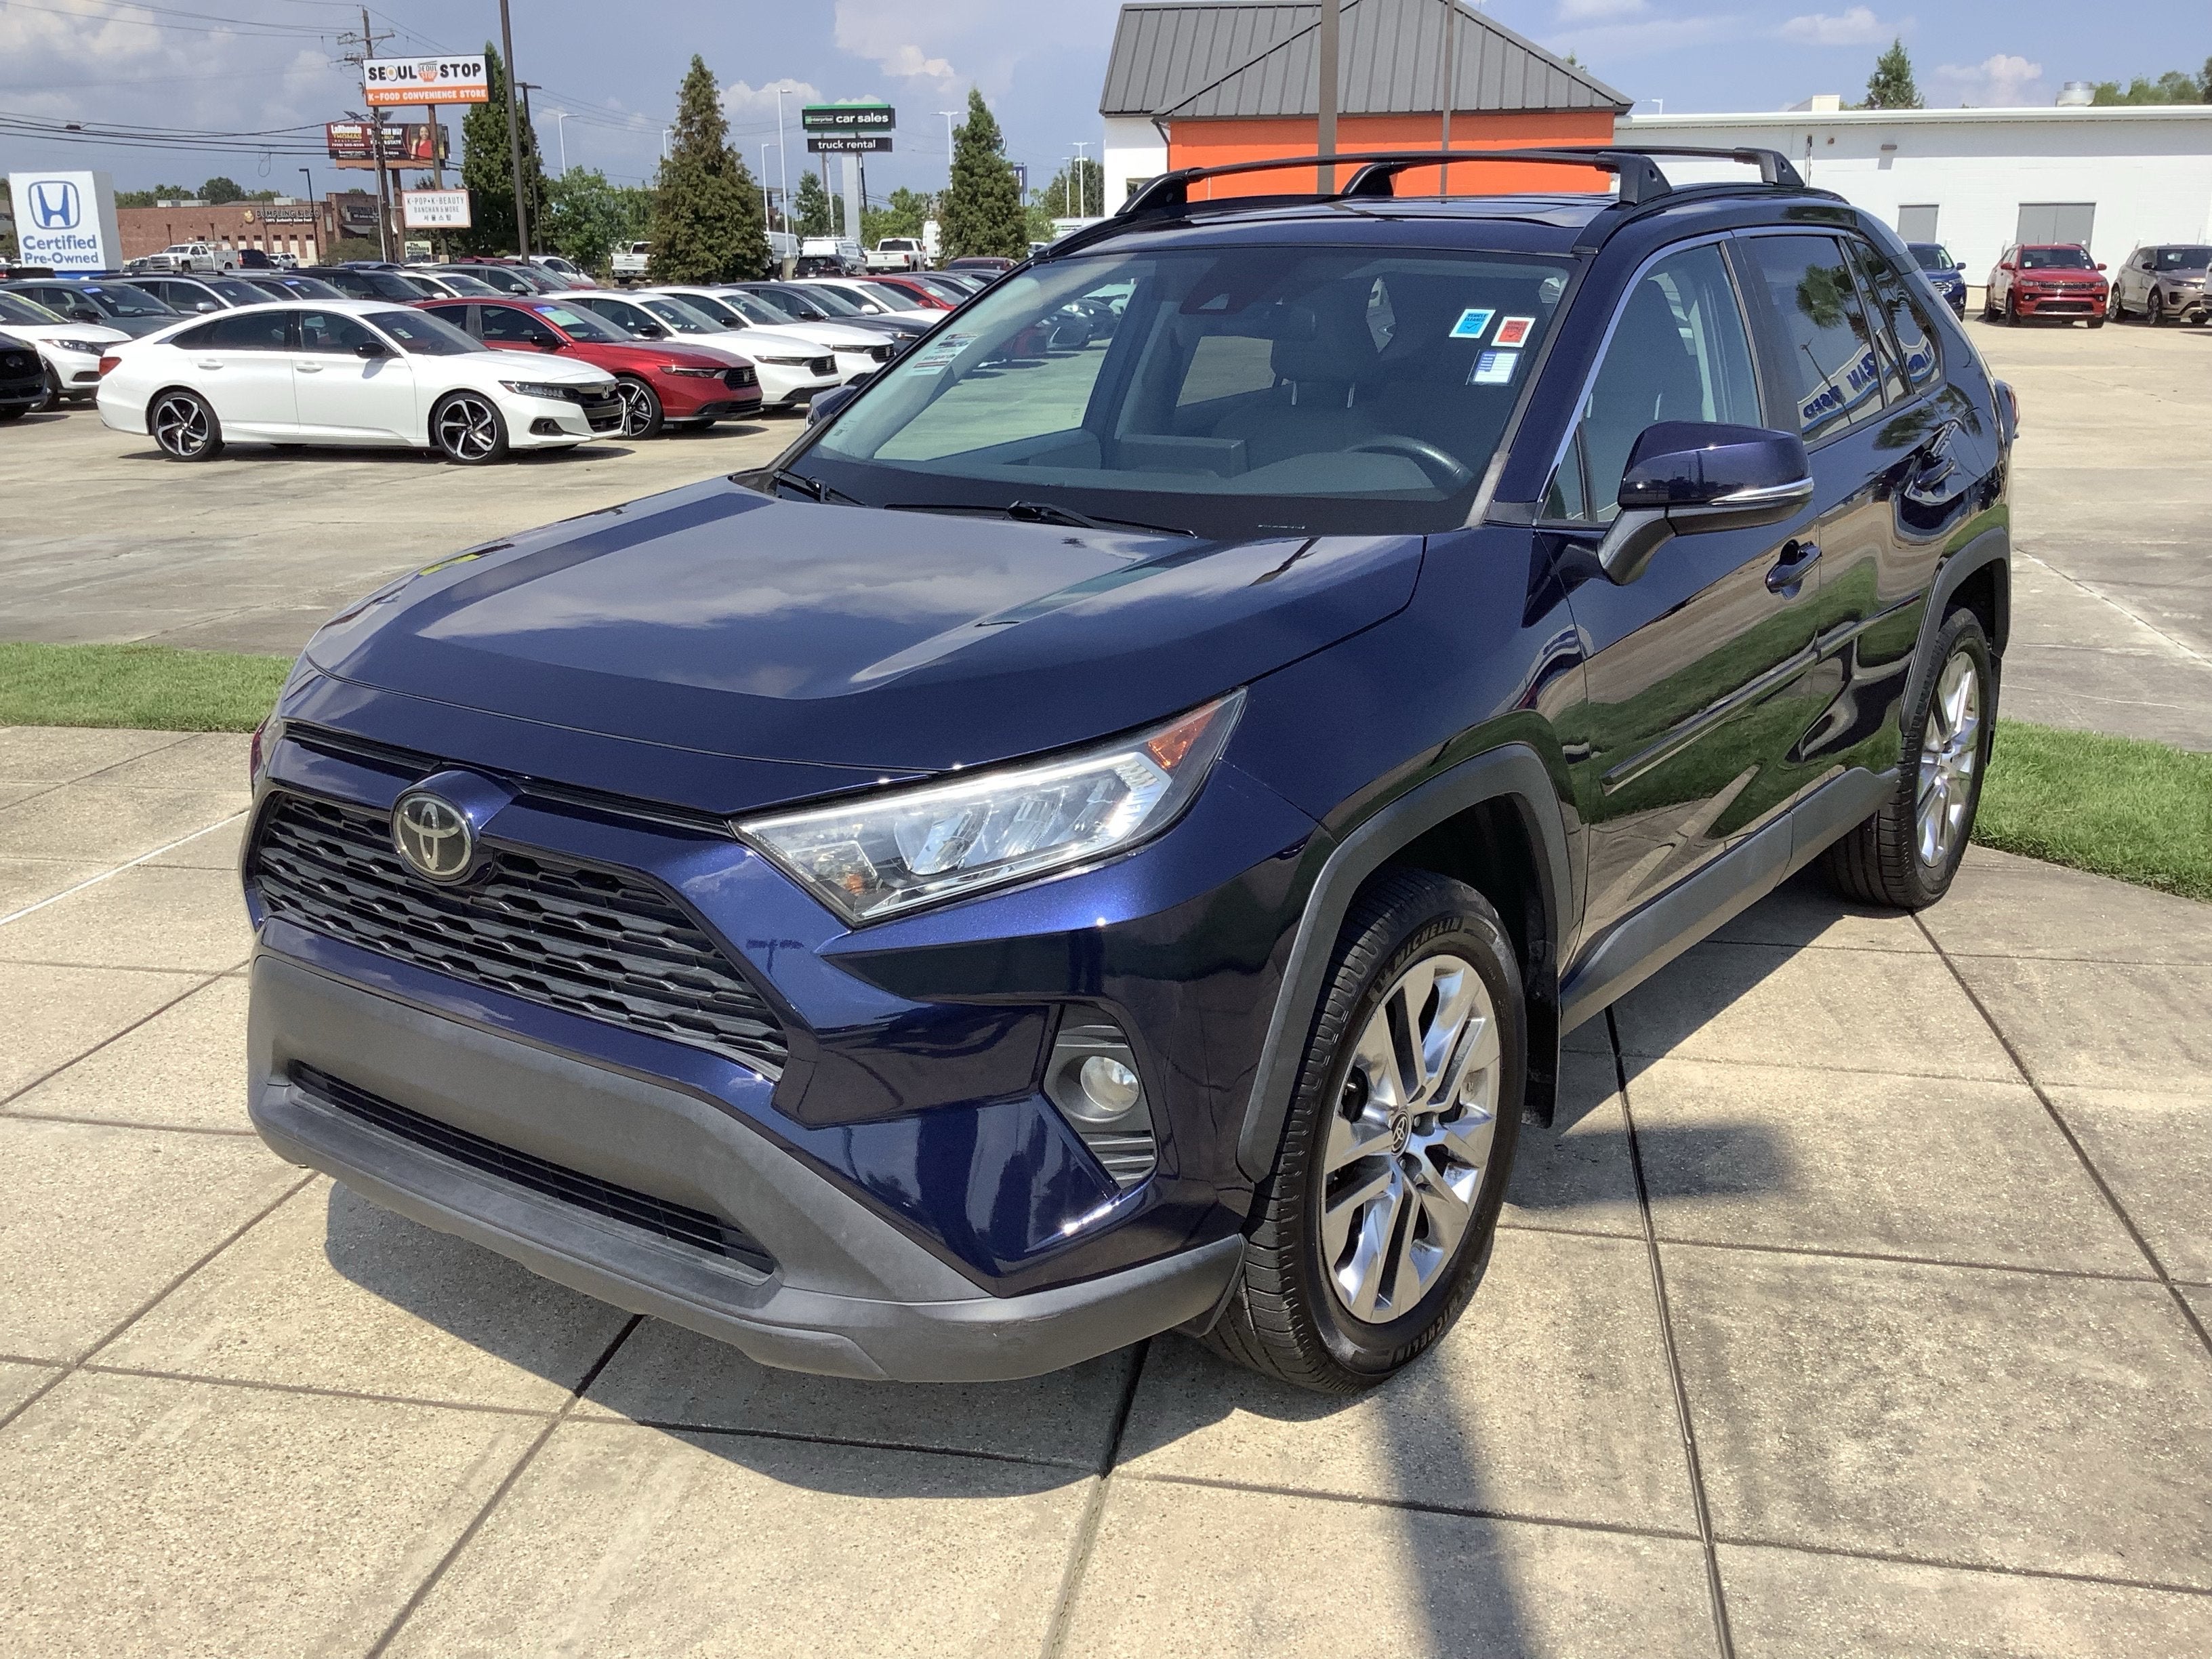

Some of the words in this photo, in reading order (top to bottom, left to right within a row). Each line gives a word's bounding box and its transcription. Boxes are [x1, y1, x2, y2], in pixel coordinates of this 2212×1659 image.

[368, 65, 417, 81] SEOUL
[440, 63, 481, 78] STOP
[368, 92, 400, 102] K-FOOD
[403, 90, 457, 100] CONVENIENCE
[459, 89, 487, 98] STORE
[857, 112, 888, 123] sales
[818, 140, 844, 149] truck
[846, 140, 876, 148] rental
[255, 209, 295, 218] DUMPLING
[304, 209, 321, 218] BAO
[22, 234, 97, 250] Certified
[24, 251, 99, 264] Pre-Owned
[1393, 916, 1462, 969] MICHELIN
[1396, 1297, 1458, 1362] MICHELIN
